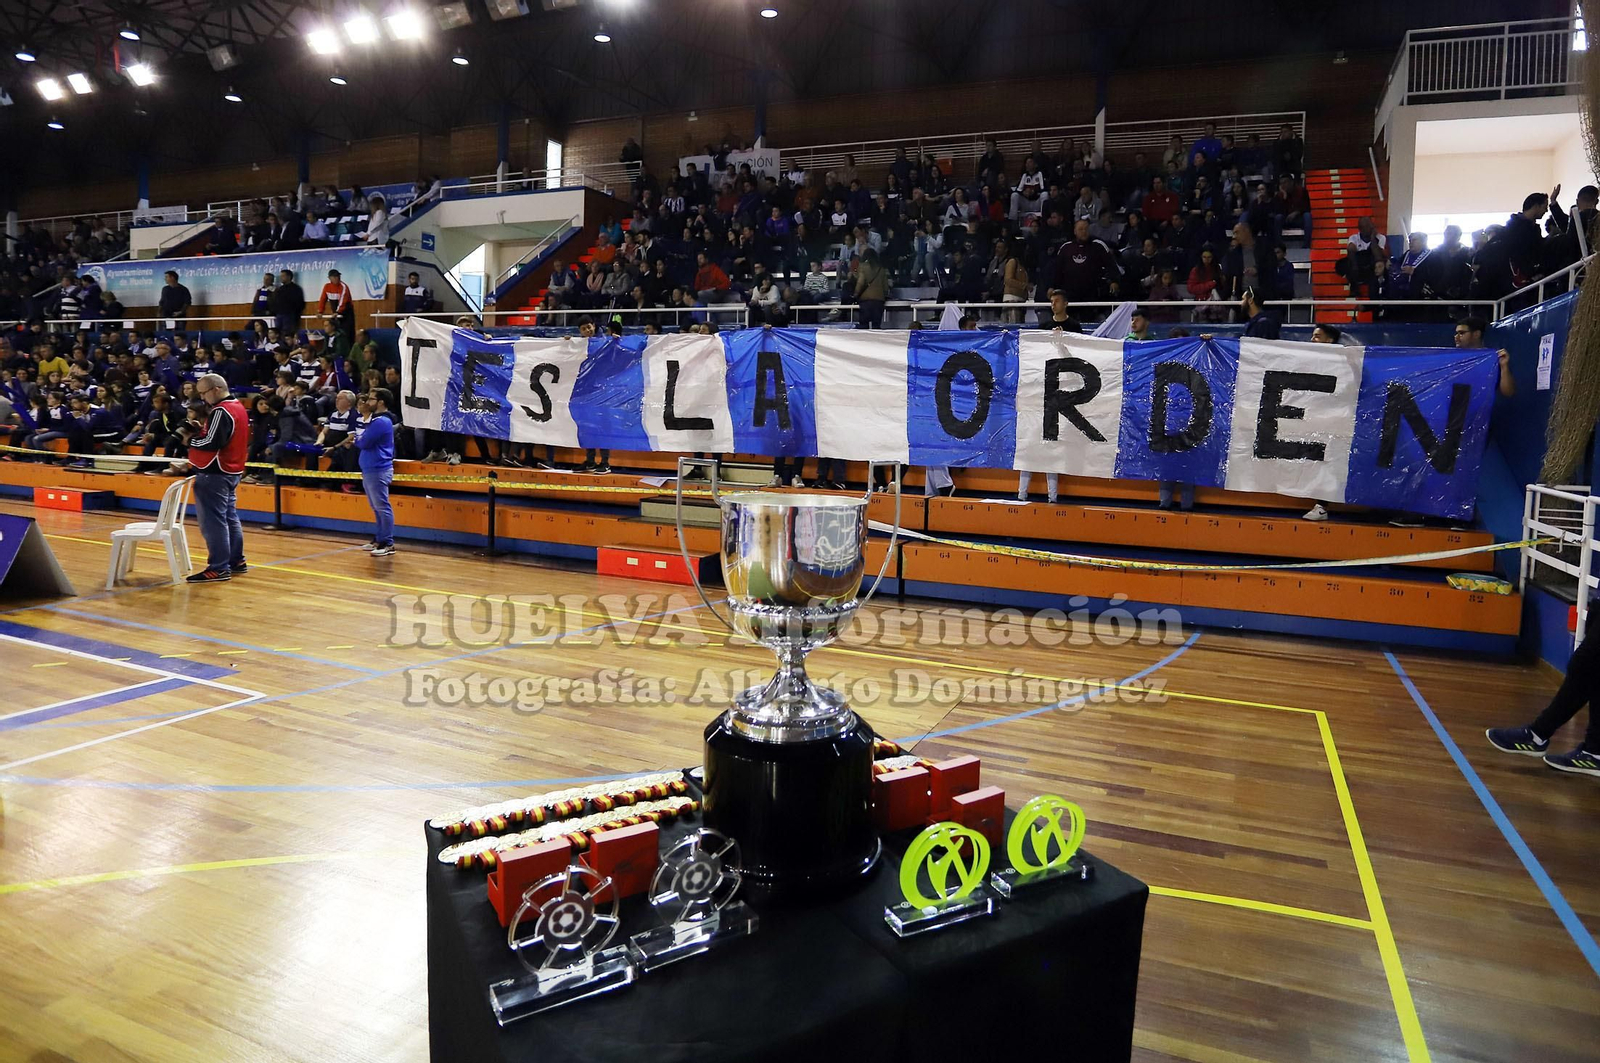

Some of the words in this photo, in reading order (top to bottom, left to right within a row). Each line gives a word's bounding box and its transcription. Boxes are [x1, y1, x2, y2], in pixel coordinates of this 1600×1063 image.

[106, 268, 153, 279] Ayuntamiento
[661, 351, 792, 431] LA
[934, 350, 1471, 476] ORDEN
[1446, 535, 1461, 543] 82
[1262, 578, 1276, 587] 76
[1326, 583, 1340, 592] 78
[1389, 588, 1404, 596] 80
[1468, 594, 1484, 603] 82
